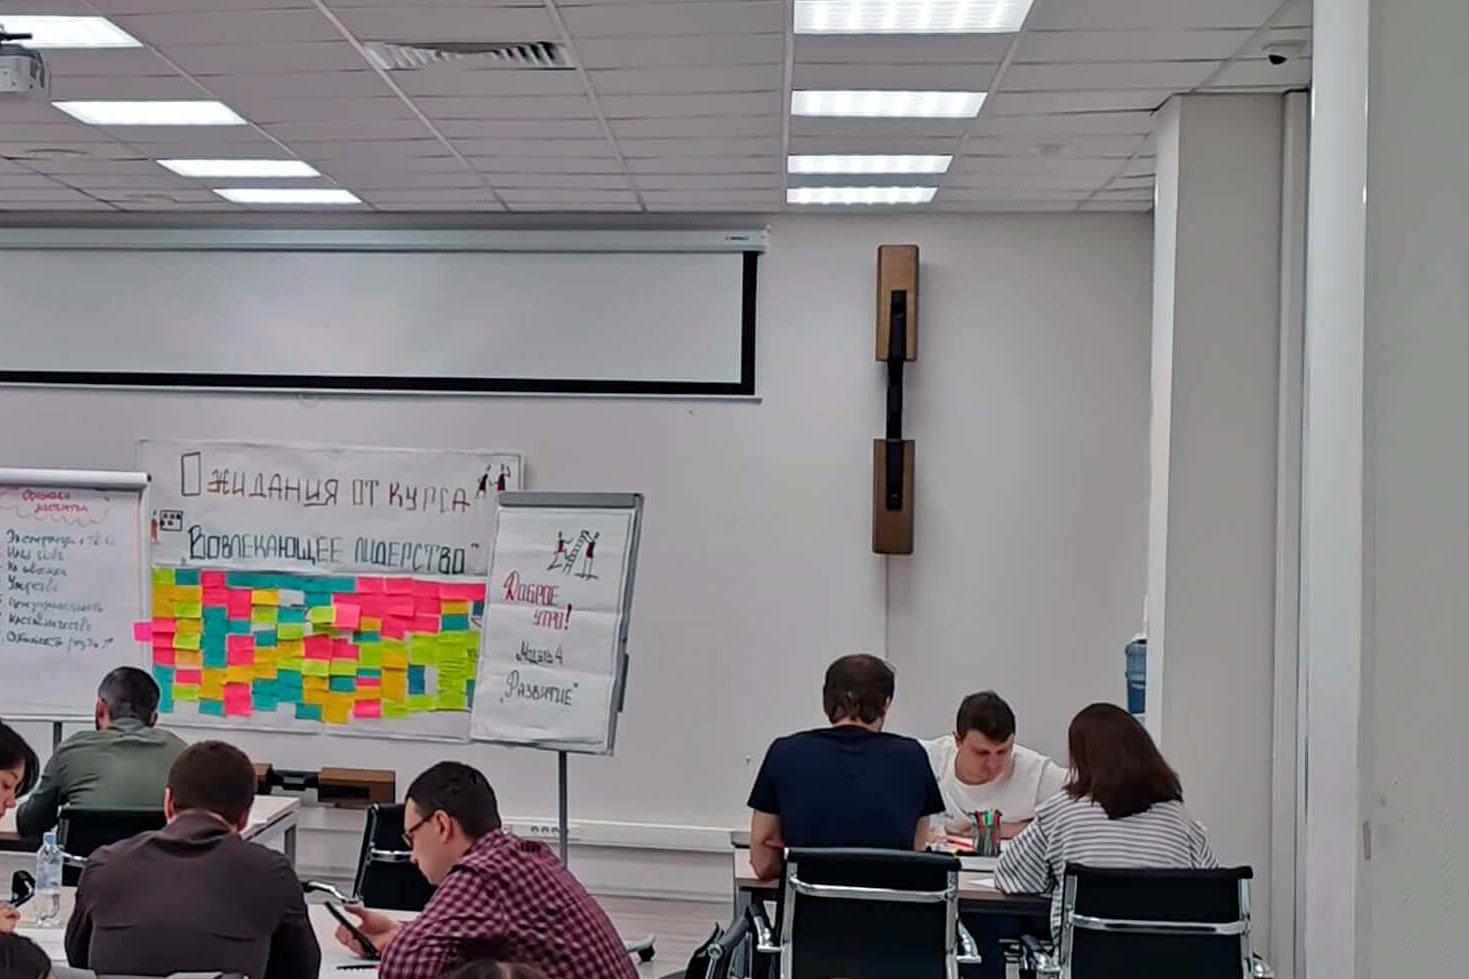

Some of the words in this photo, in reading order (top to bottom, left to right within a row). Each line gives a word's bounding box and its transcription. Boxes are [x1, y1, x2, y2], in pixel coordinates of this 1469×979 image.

[181, 451, 339, 507] ОЖИДАНИЯ
[352, 478, 379, 507] ОТ
[388, 481, 471, 513] КУРСА
